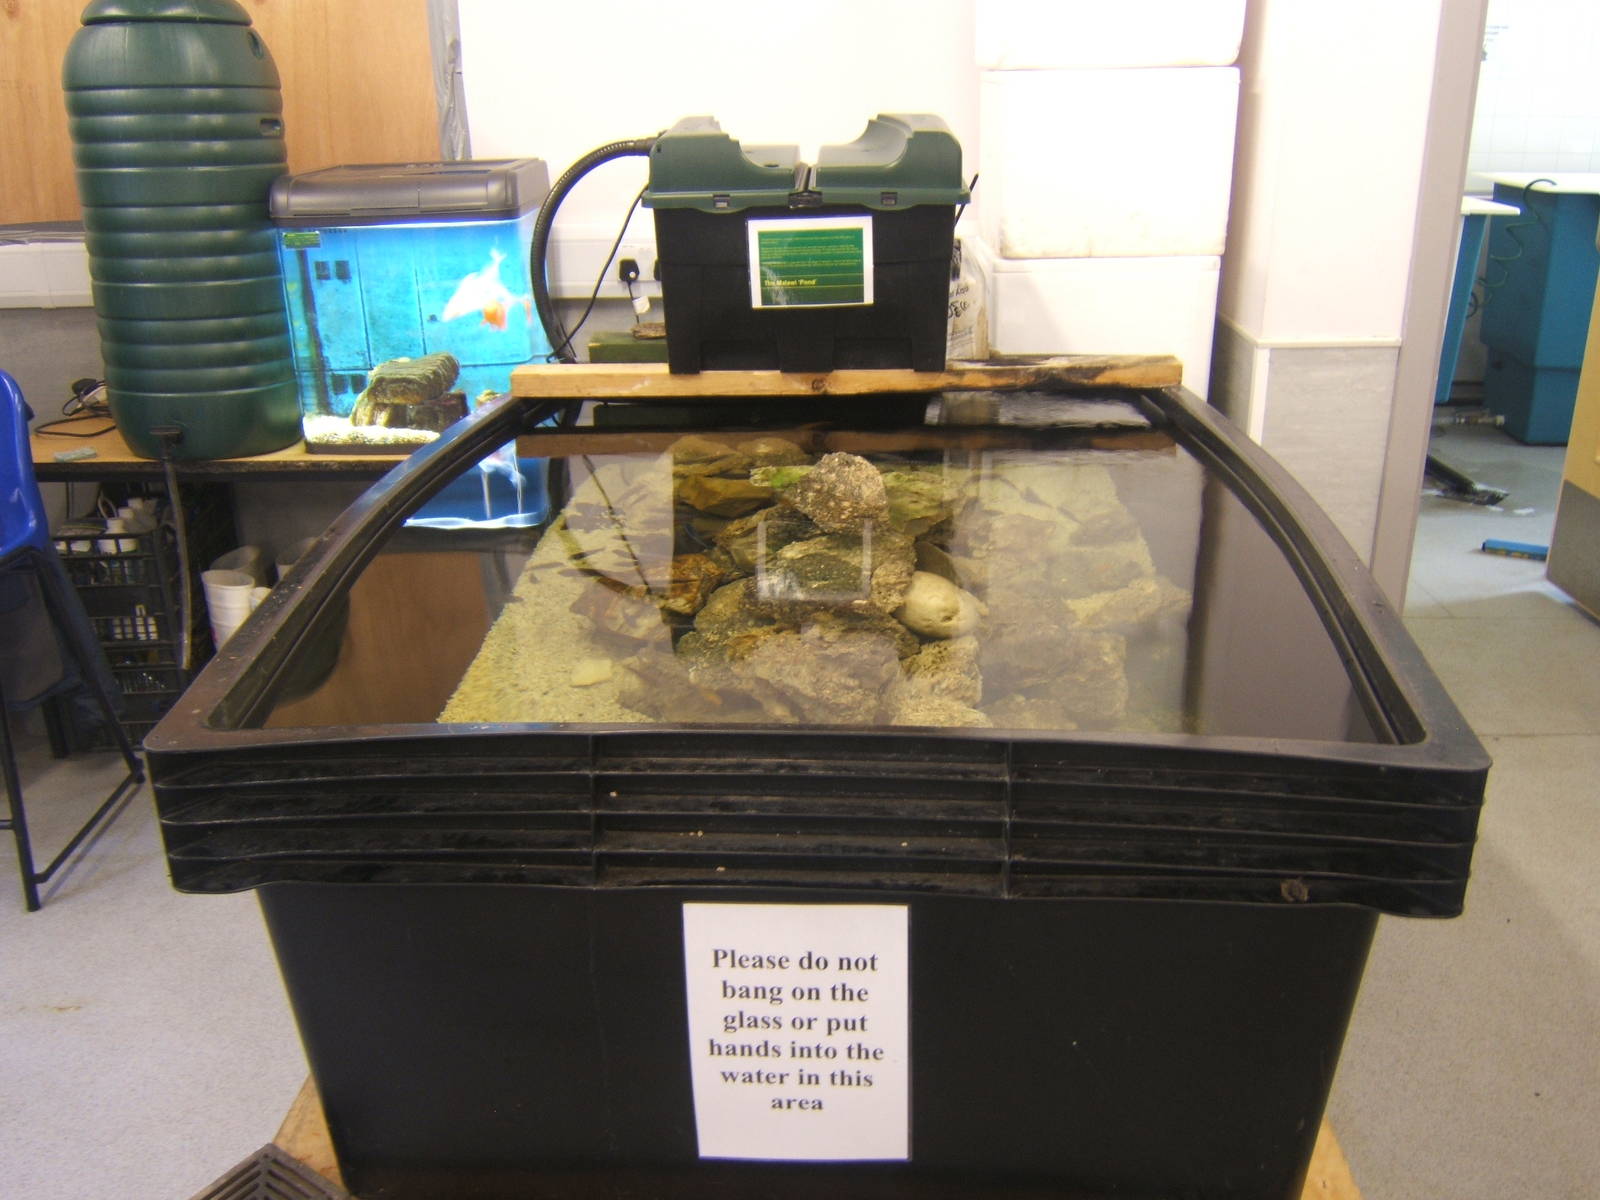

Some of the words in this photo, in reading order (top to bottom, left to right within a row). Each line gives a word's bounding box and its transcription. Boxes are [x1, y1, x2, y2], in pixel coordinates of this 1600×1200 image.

[713, 949, 790, 970] Please
[799, 951, 829, 971] do
[837, 953, 879, 972] not
[722, 980, 784, 1004] bang
[791, 985, 821, 1001] on
[830, 983, 869, 1002] the
[723, 1010, 783, 1033] glass
[791, 1016, 818, 1030] or
[826, 1014, 869, 1035] put
[708, 1039, 782, 1058] hands
[790, 1041, 837, 1060] into
[846, 1043, 884, 1060] the
[720, 1069, 790, 1085] water
[798, 1069, 820, 1086] in
[830, 1070, 874, 1087] this
[771, 1097, 824, 1111] area
